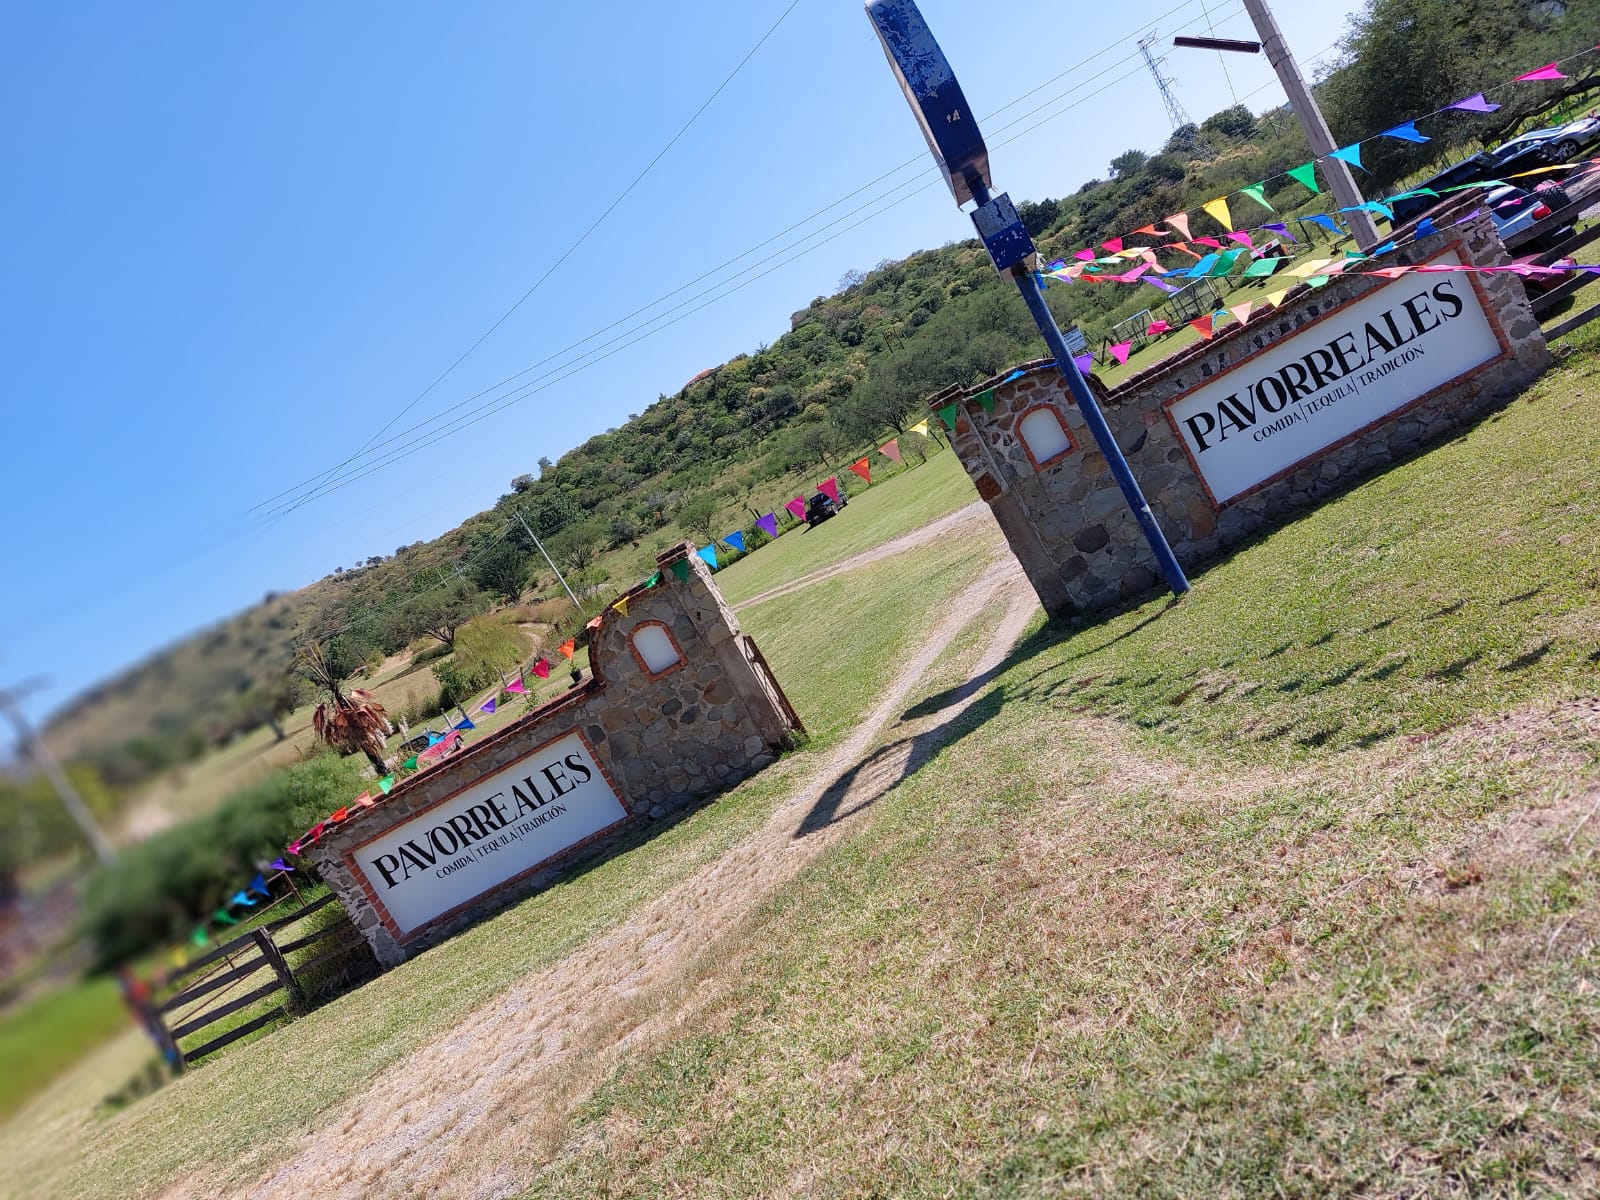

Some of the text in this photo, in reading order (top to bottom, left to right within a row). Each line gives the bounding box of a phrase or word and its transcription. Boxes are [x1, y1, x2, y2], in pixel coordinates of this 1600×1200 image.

[1183, 279, 1463, 453] PAVORREALES
[1253, 344, 1425, 442] COMIDA TEQUILA TRADICIÓN
[370, 752, 592, 889] PAVORREALES
[436, 803, 568, 879] COMIDA TEQUILA TRADICIÓN
